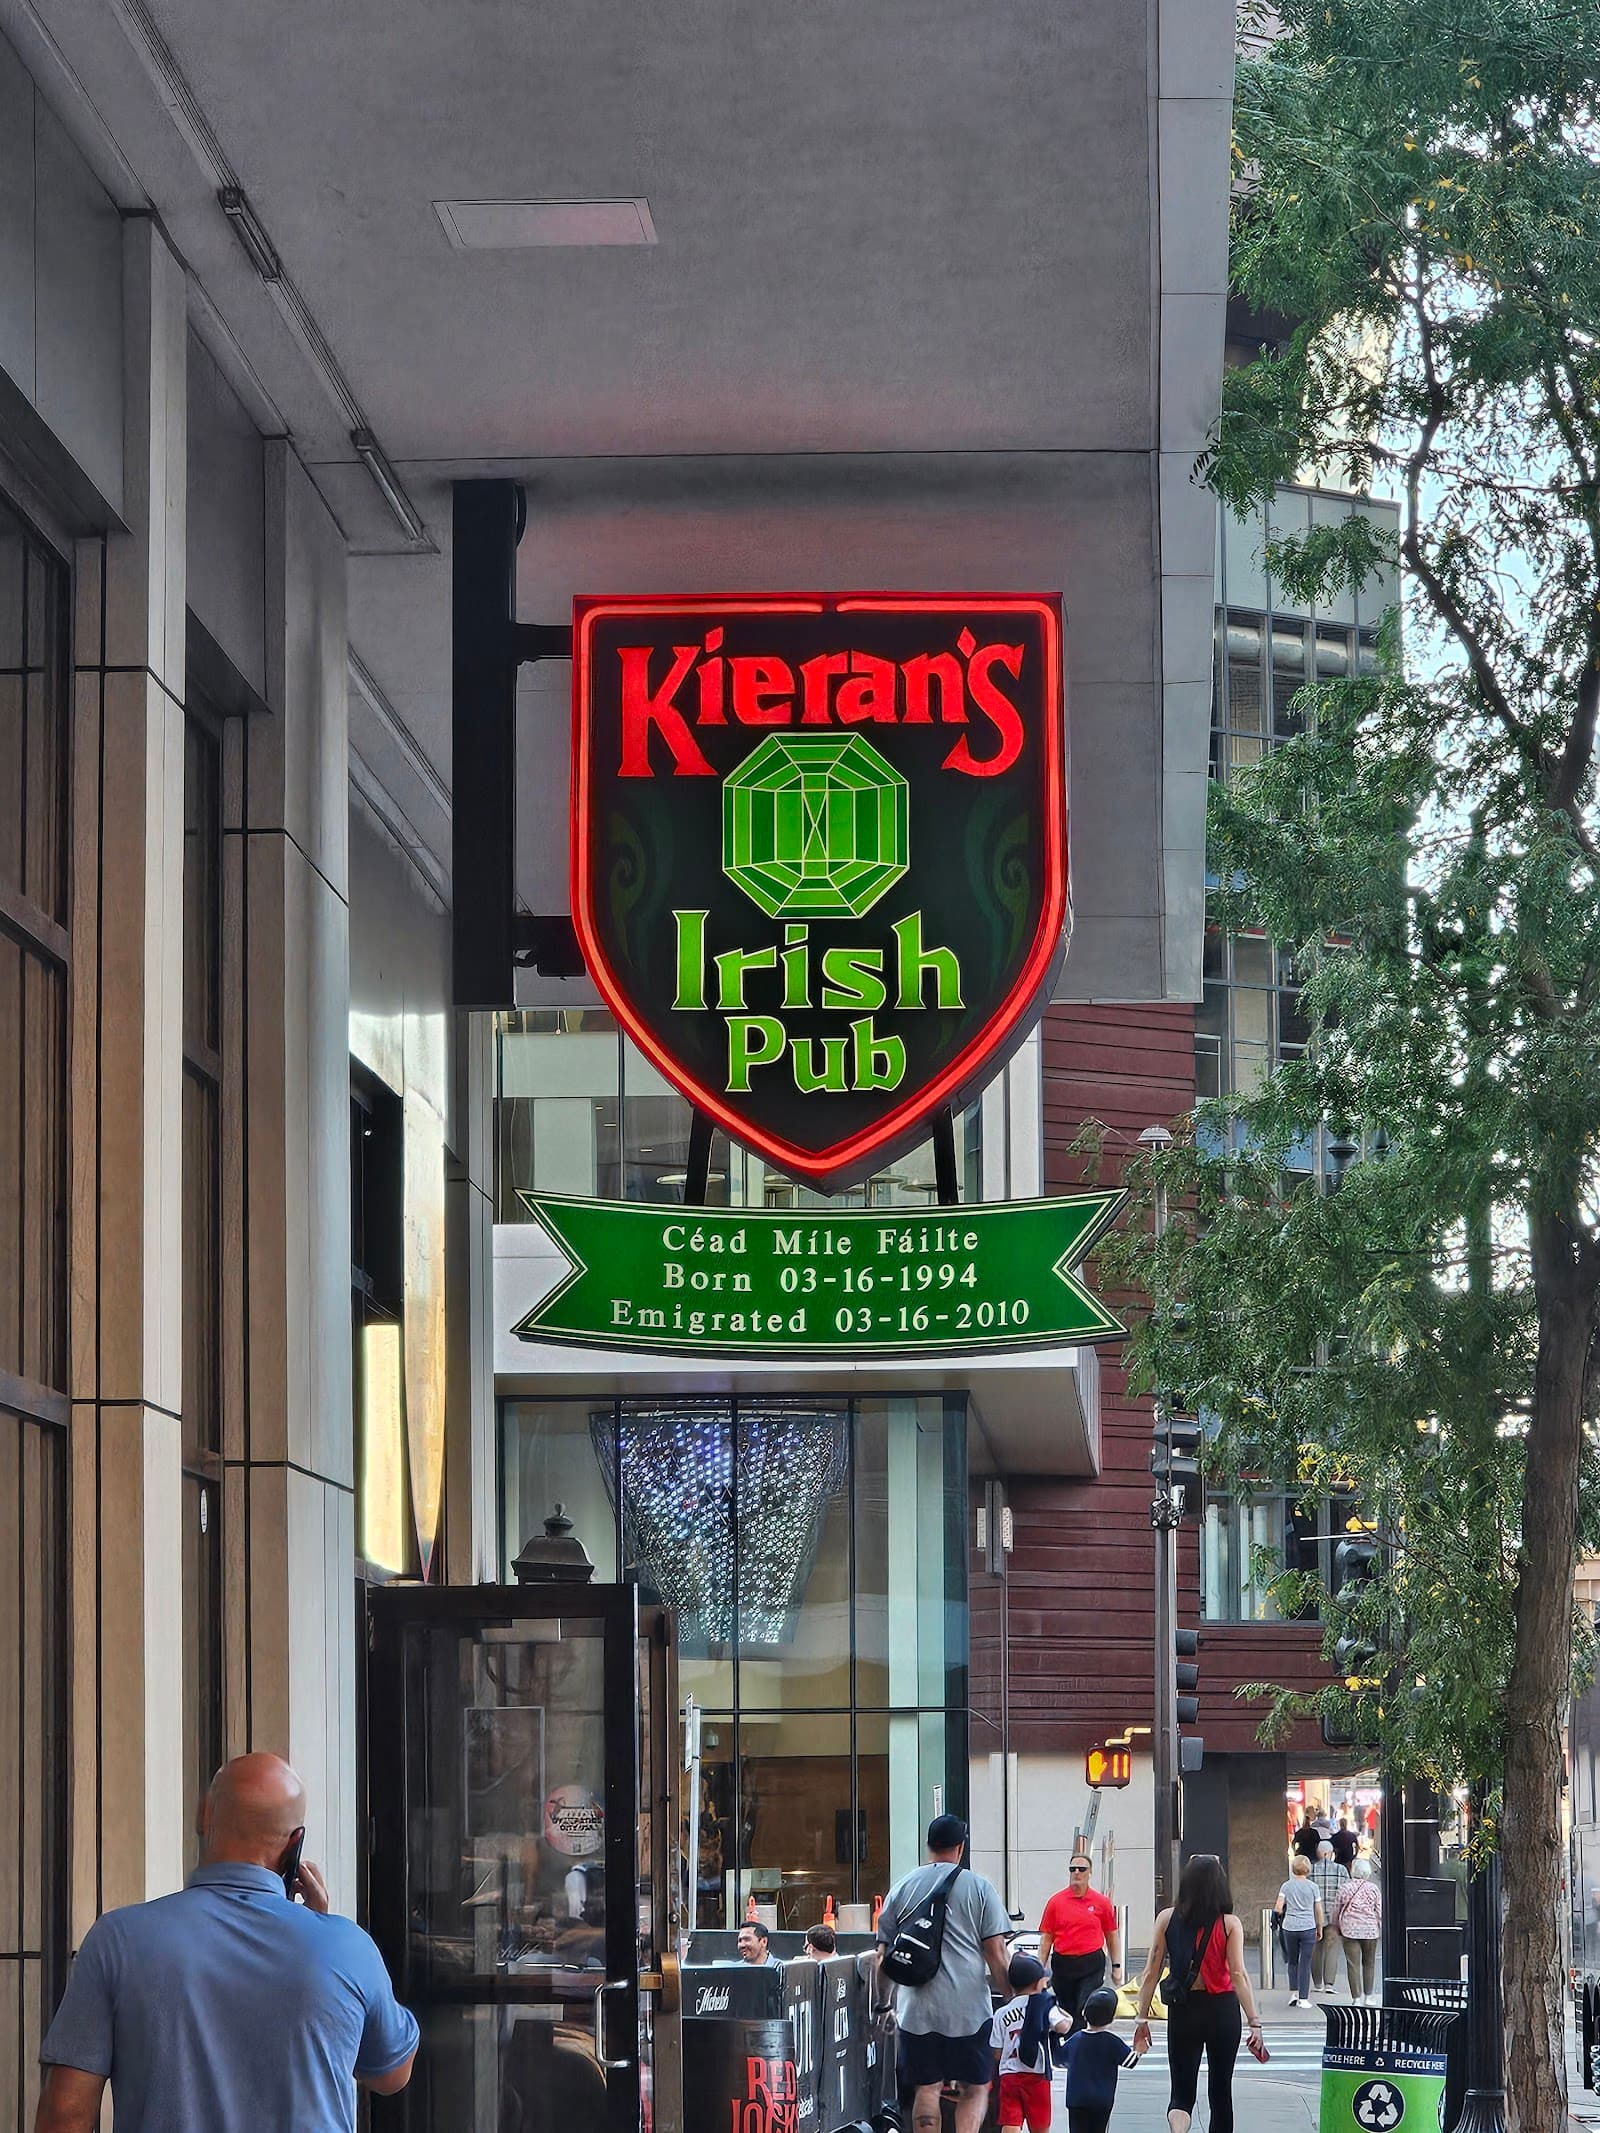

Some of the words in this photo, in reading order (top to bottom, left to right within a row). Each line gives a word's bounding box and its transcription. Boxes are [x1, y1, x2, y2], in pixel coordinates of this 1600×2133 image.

[617, 627, 1024, 776] Kieran's
[671, 909, 966, 1010] Irish
[724, 1015, 907, 1094] Pub
[662, 1226, 747, 1254] Céad
[772, 1229, 852, 1255] Míle
[877, 1227, 979, 1255] Fáilte
[663, 1263, 753, 1292] Born
[780, 1263, 978, 1293] 03-16-1994
[610, 1300, 807, 1334] Emigrated
[835, 1299, 1030, 1333] 03-16-2010
[1343, 2055, 1366, 2066] HERE
[1394, 2058, 1432, 2070] RECYCLE
[746, 2056, 798, 2102] RED
